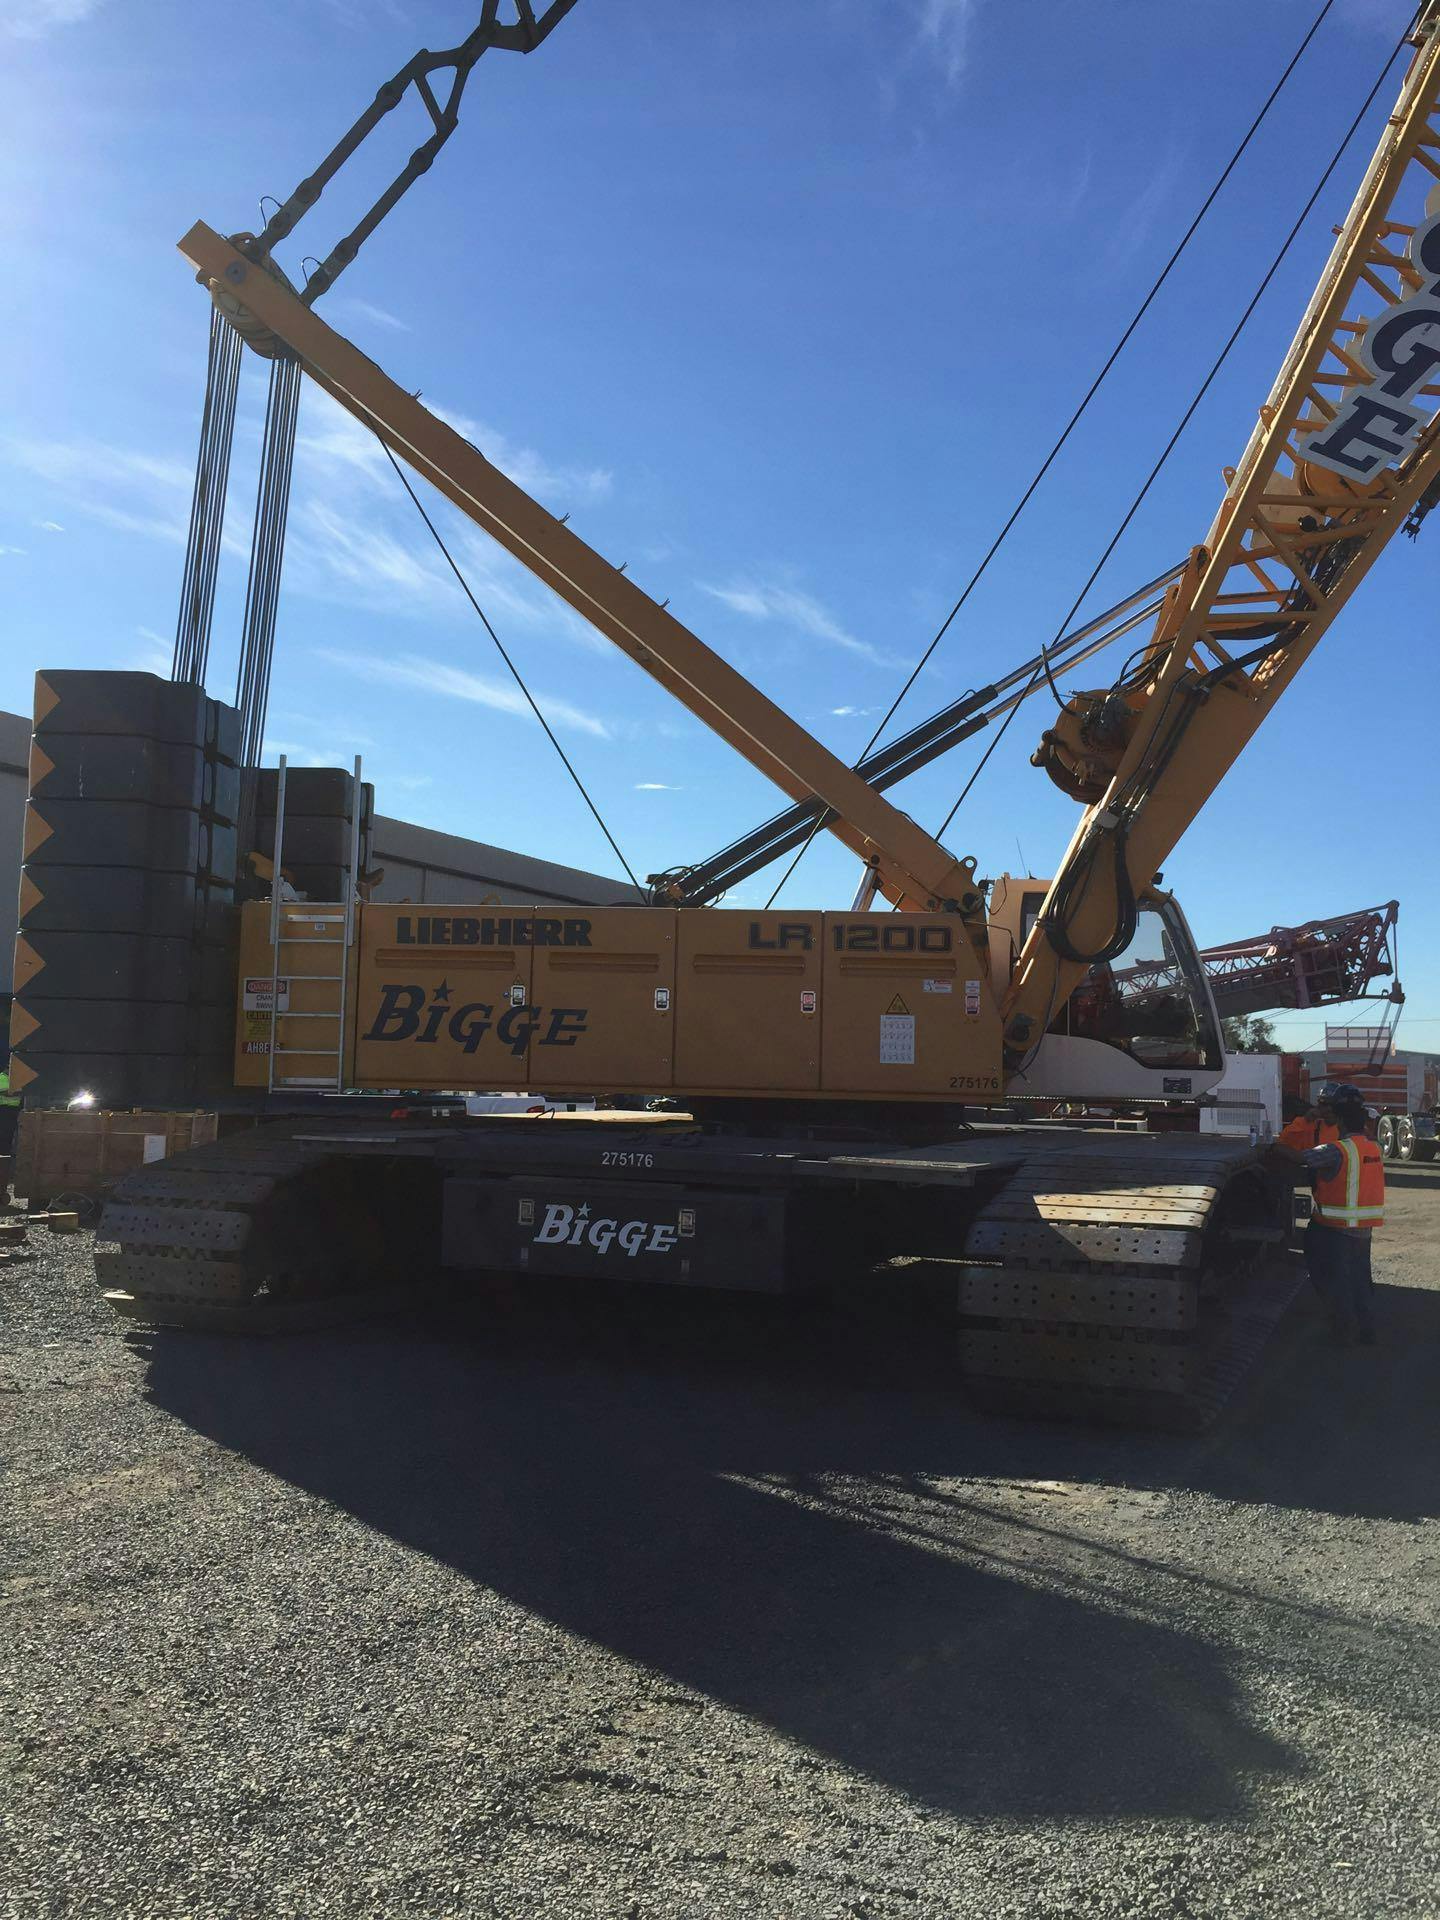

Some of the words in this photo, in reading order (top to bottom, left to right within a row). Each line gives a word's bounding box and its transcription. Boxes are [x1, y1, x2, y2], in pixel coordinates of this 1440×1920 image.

[396, 917, 593, 947] LIEBHERR
[749, 922, 812, 950] LR
[832, 924, 953, 952] 1200
[950, 1076, 999, 1089] 275176
[601, 1151, 654, 1168] 275176
